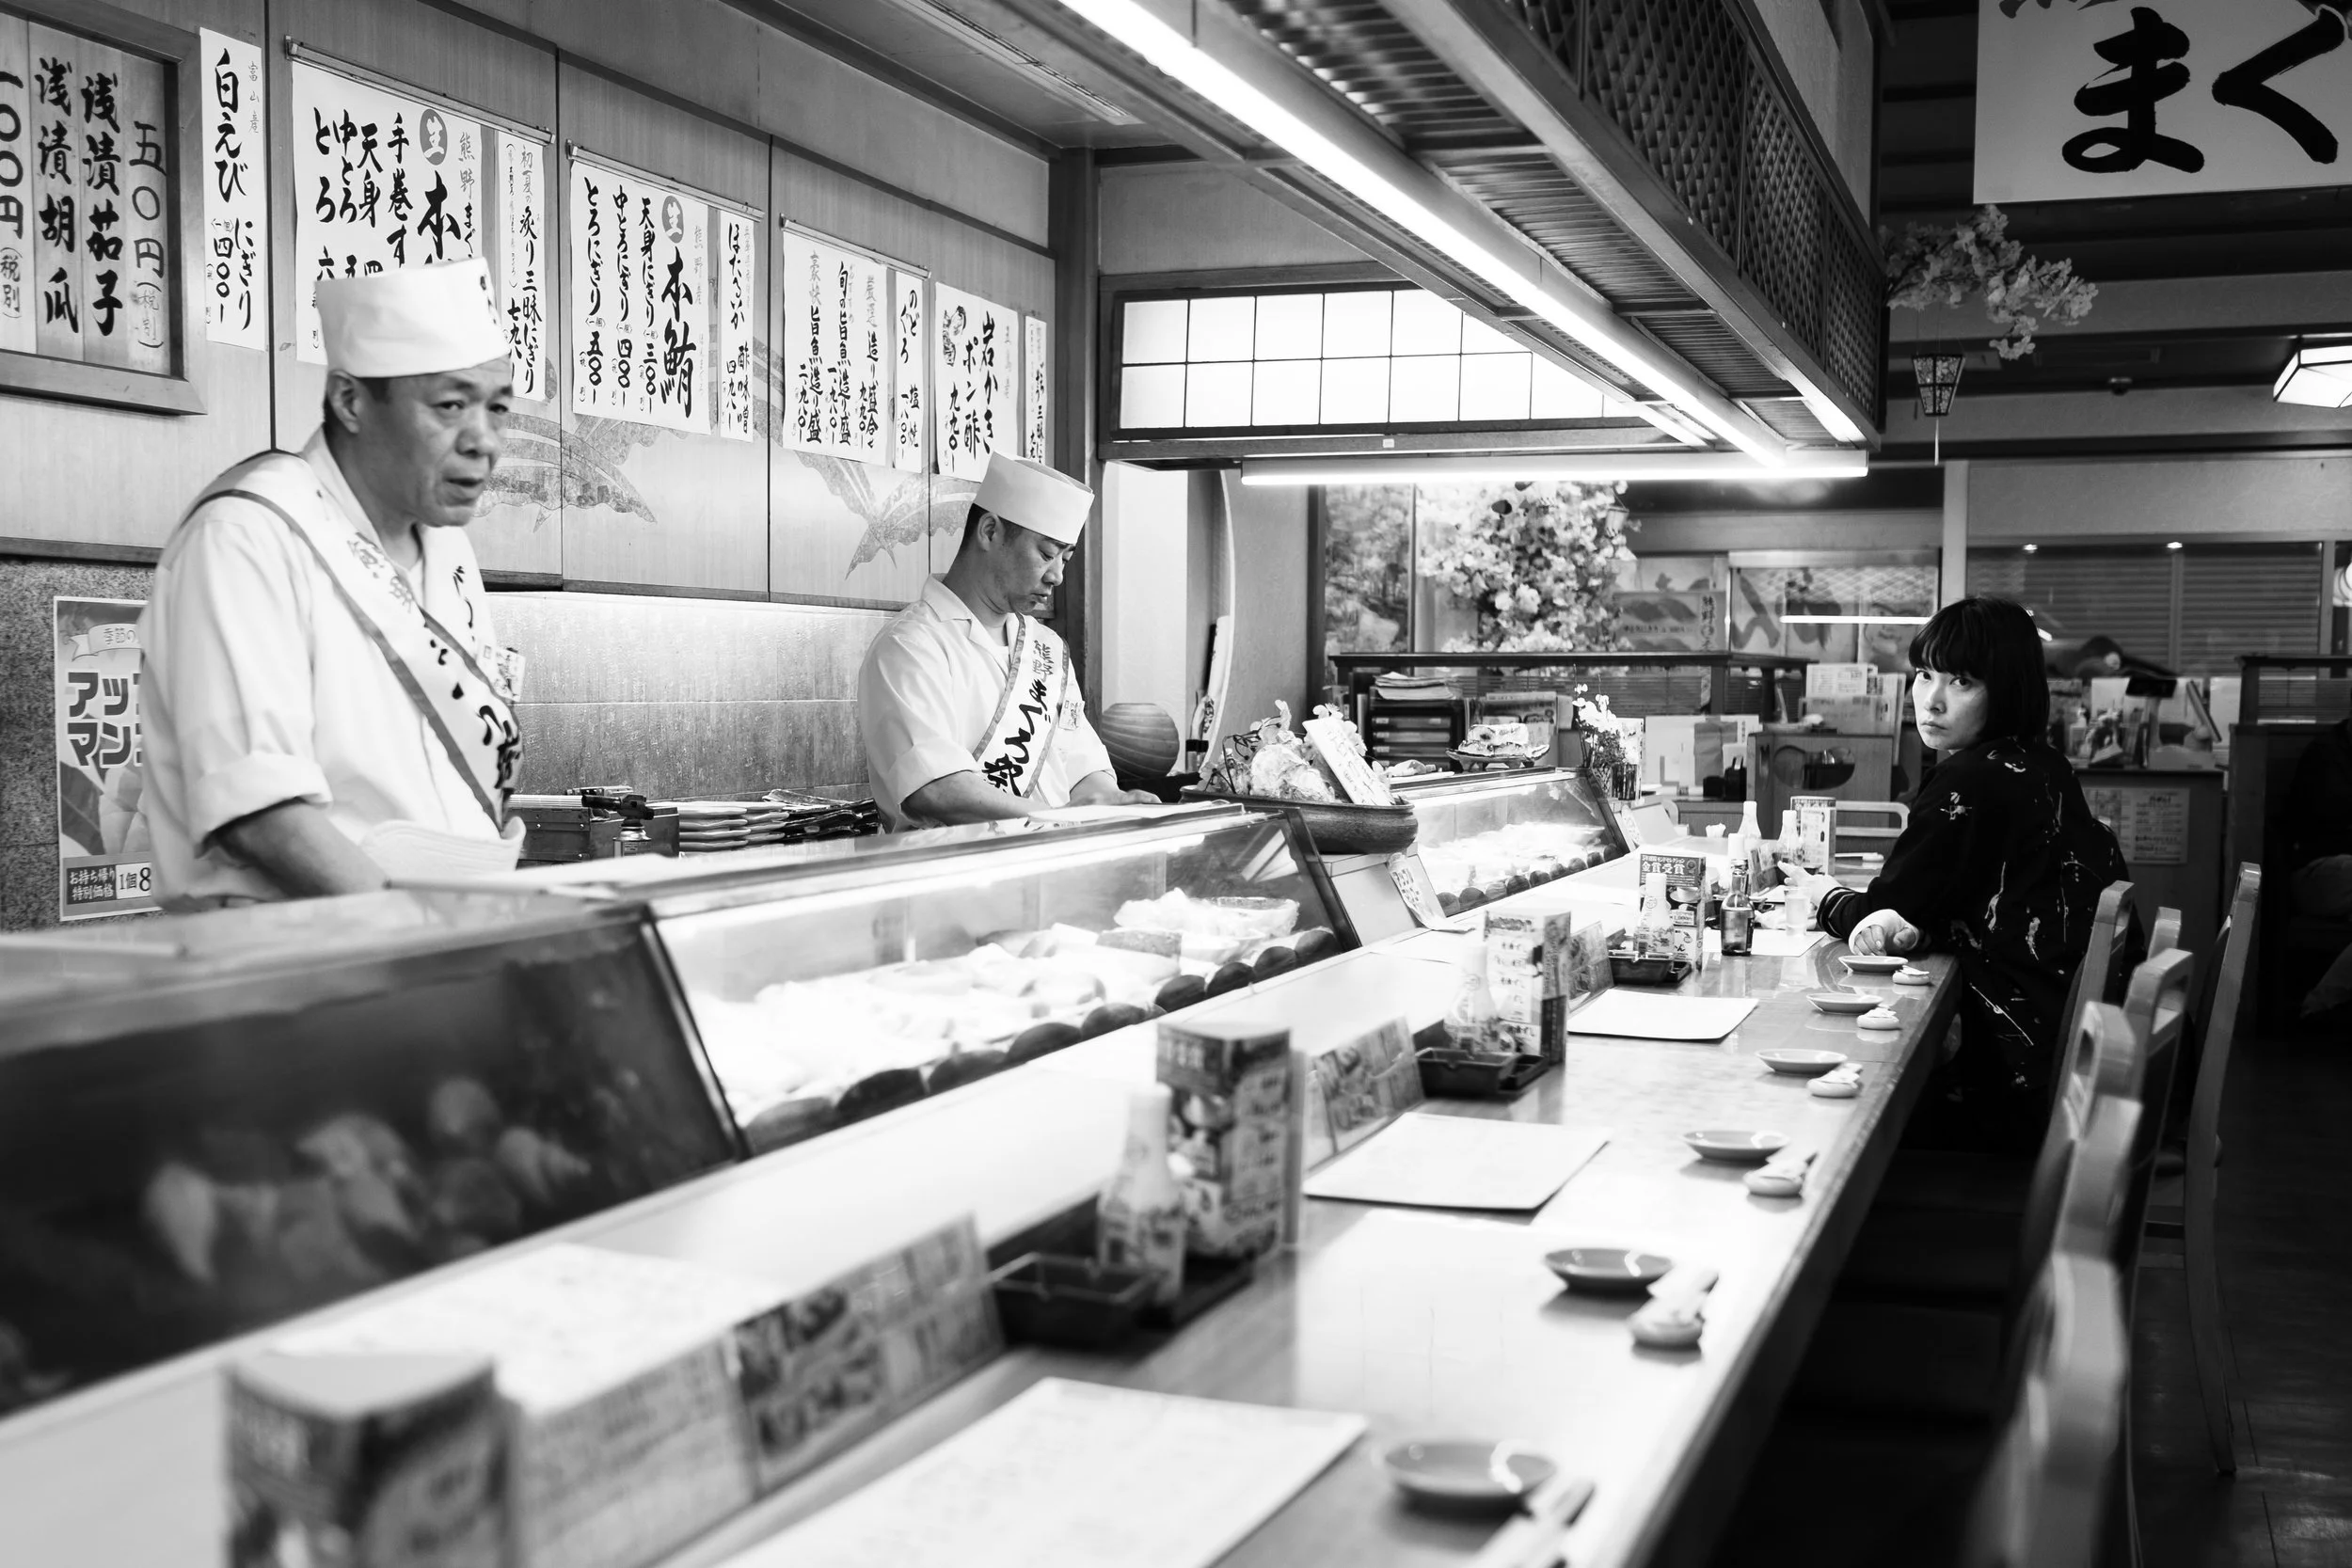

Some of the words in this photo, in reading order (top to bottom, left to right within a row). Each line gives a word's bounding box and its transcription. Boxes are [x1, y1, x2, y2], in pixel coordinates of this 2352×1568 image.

[215, 48, 248, 202] 白えび
[313, 106, 336, 223] とろ
[333, 109, 358, 224] 中とろ
[358, 122, 384, 228] 天身
[35, 56, 79, 334] 浅漬胡瓜
[81, 72, 123, 337] 浅漬茄子
[458, 132, 476, 259] 熊野まぐ
[583, 176, 604, 316] とろにぎり
[233, 217, 254, 330] にぎり
[612, 184, 631, 323] 中とろにぎり
[727, 222, 745, 330] ほたるいか
[660, 245, 697, 419] 本鮪
[737, 341, 751, 434] 酢味噌
[962, 336, 981, 460] ポン酢
[67, 671, 142, 718] アッ
[67, 721, 143, 767] マン
[69, 867, 115, 885] お持ち帰り
[72, 882, 114, 901] 特別価格
[1642, 861, 1686, 876] 金賞受賞
